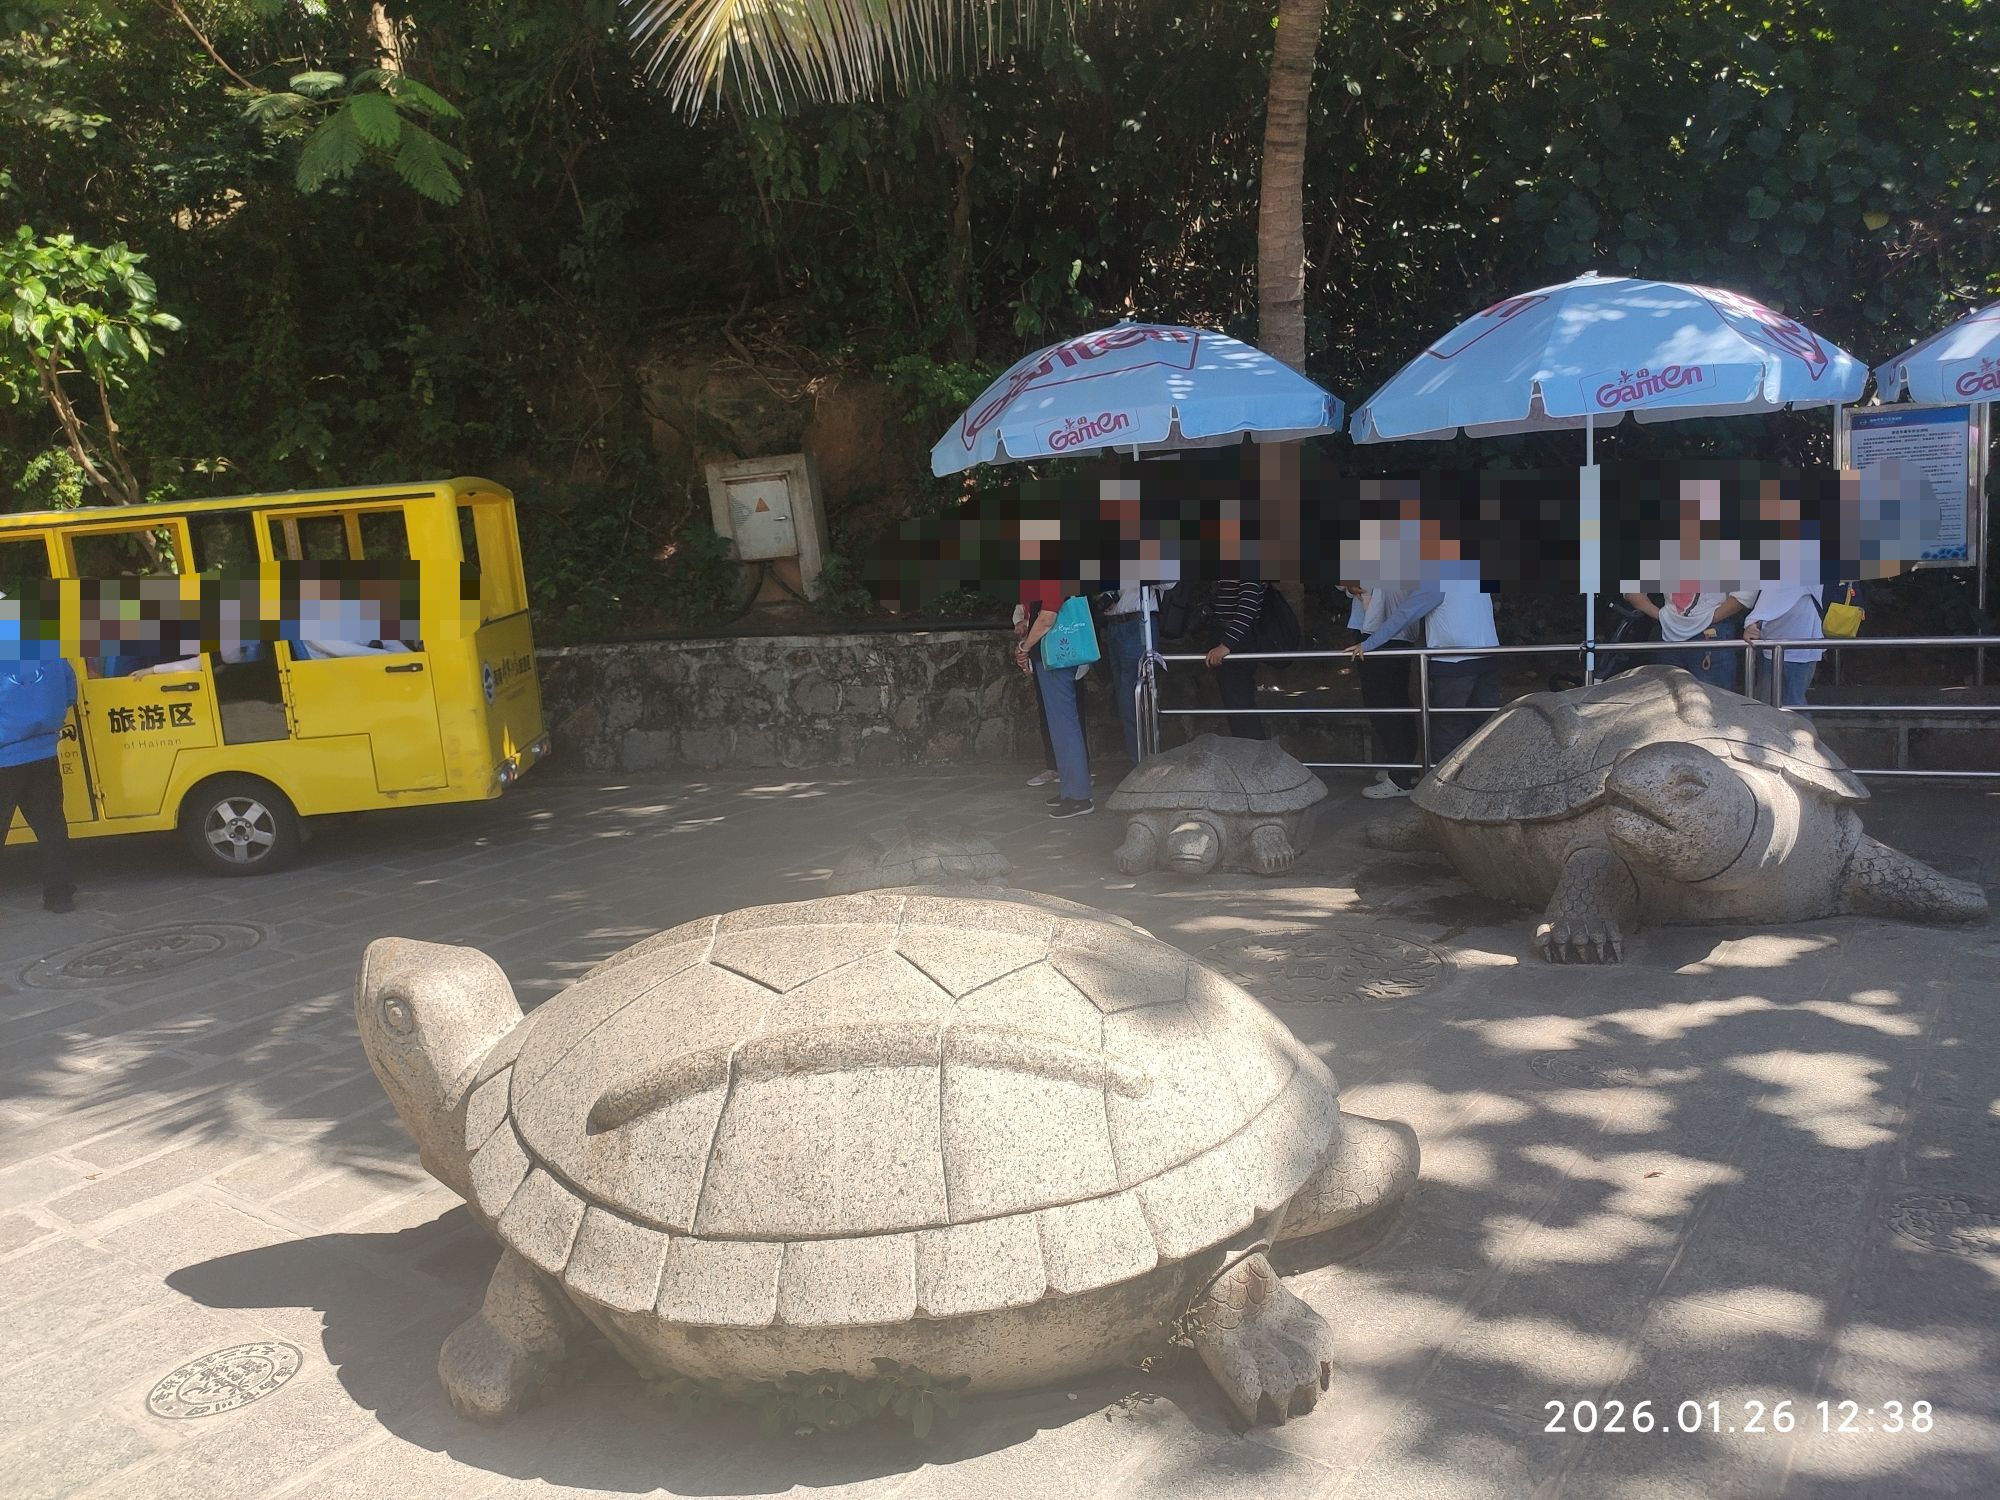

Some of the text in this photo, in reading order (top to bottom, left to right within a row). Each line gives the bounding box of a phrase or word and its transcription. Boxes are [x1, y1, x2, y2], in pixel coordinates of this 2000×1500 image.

[1595, 364, 1703, 408] Ganten
[1048, 411, 1130, 451] Ganten
[107, 702, 196, 734] 旅游区
[123, 740, 135, 750] of
[138, 737, 182, 749] Hainan
